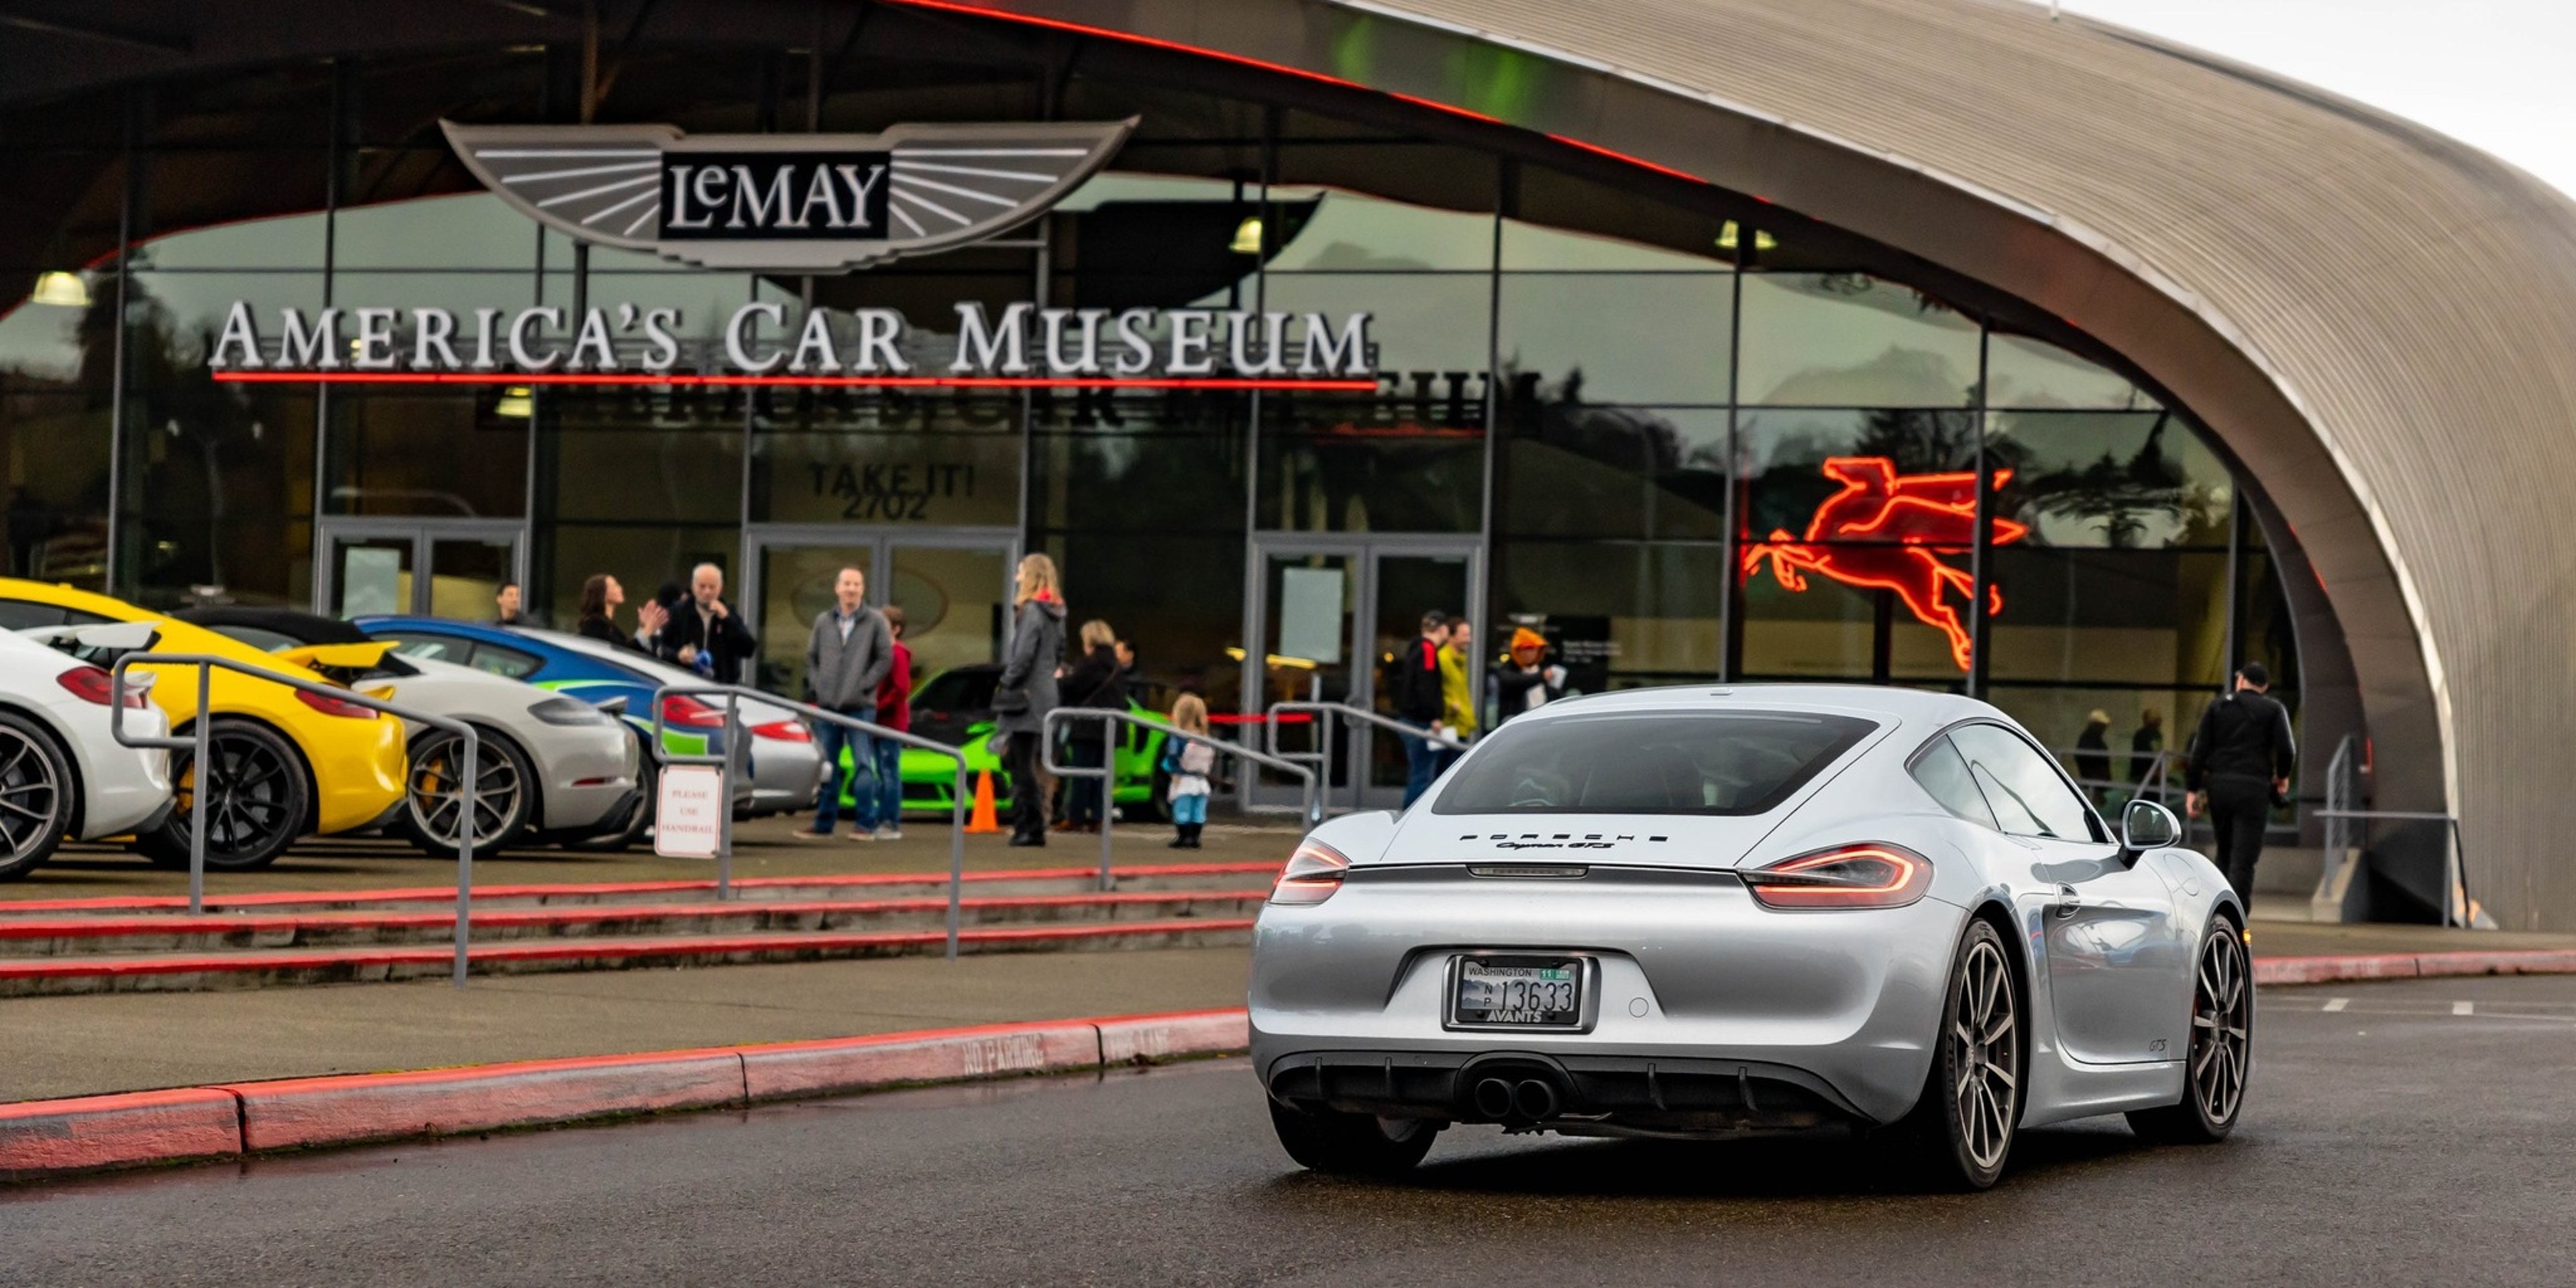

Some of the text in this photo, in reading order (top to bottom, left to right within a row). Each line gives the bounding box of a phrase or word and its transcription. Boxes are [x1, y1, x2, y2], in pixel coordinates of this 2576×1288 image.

[667, 163, 887, 229] LeMAY
[208, 299, 1374, 376] AMERICA'S CAR MUSEUM
[808, 463, 910, 496] TAKE
[672, 790, 708, 800] PLEASE
[680, 807, 699, 816] USE
[661, 824, 713, 835] HANDRAIL
[1460, 834, 1668, 843] PORSCHE
[1468, 968, 1532, 977] WASHINGTON
[1541, 969, 1552, 977] 11
[1502, 981, 1572, 1011] 13633
[1486, 1010, 1542, 1022] AVANTS
[2149, 1039, 2167, 1051] GTS
[963, 1033, 1044, 1076] NO PARKING
